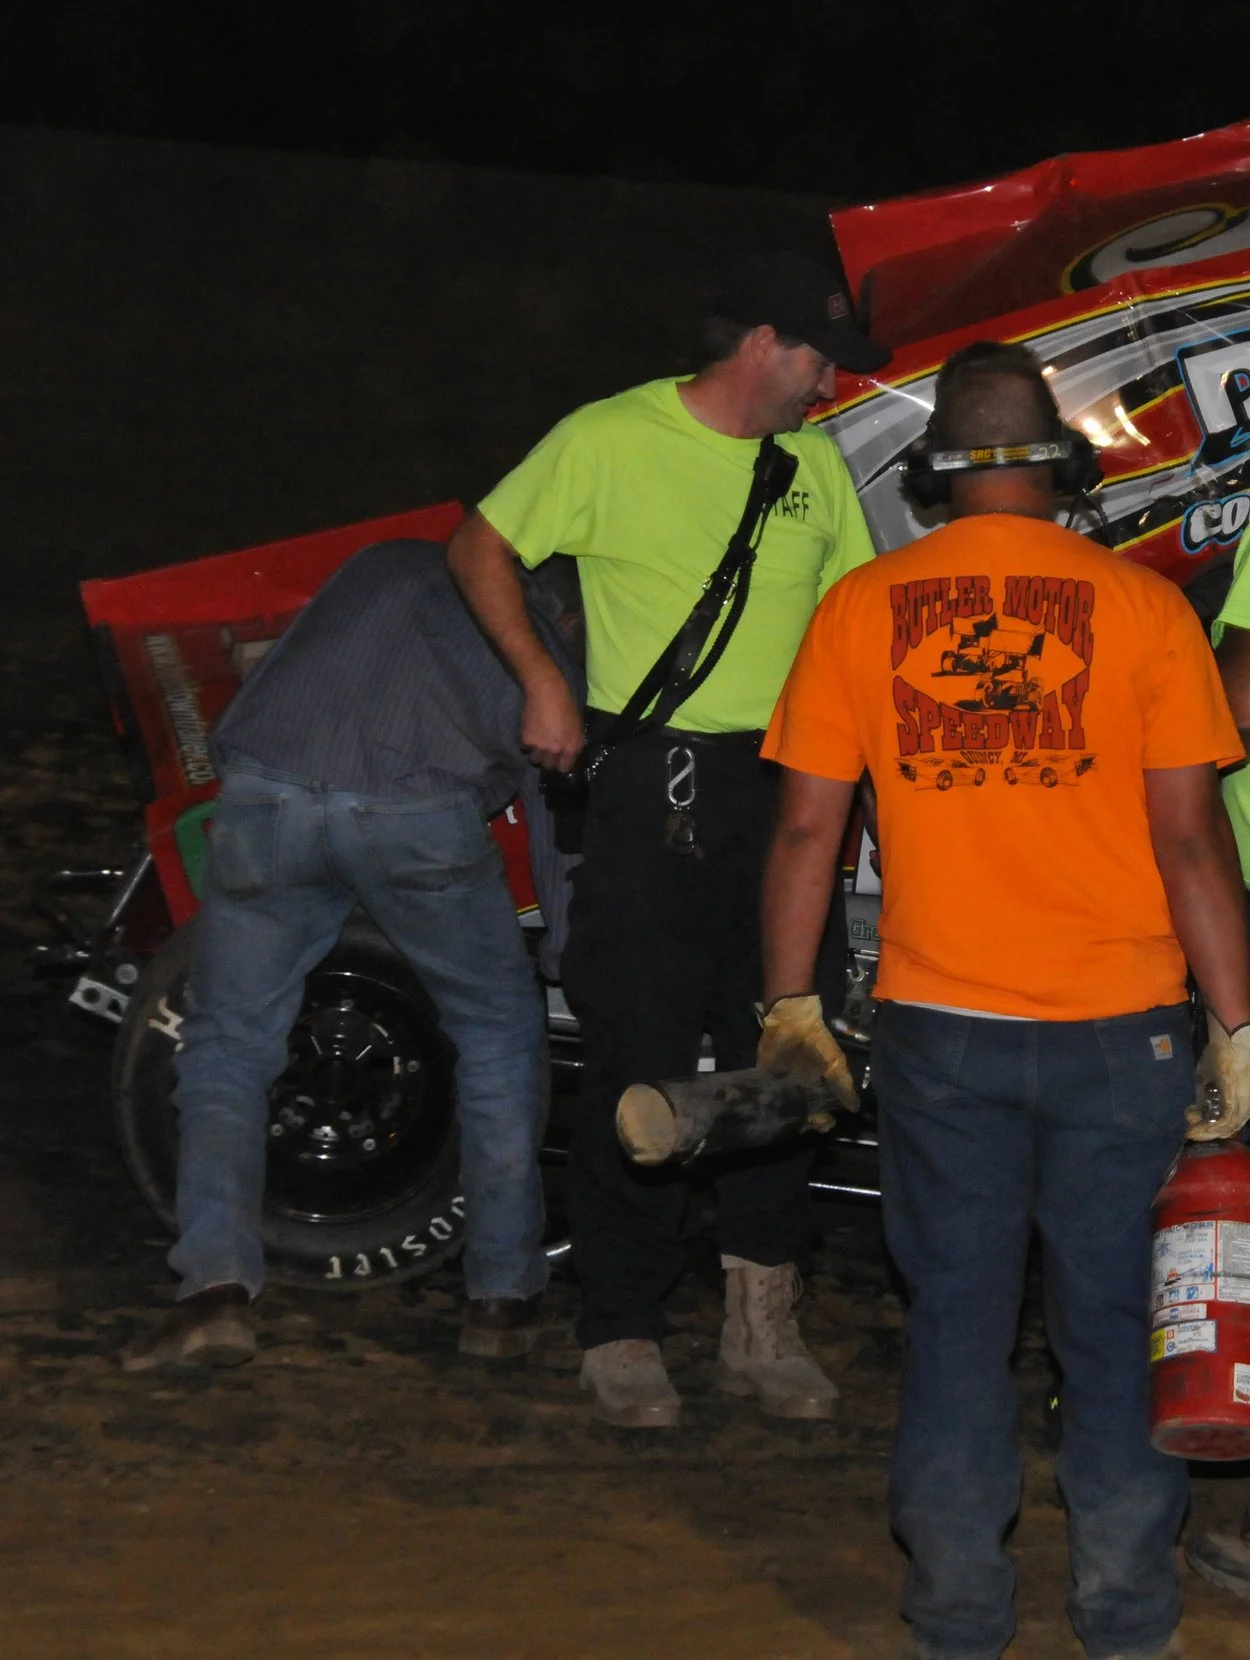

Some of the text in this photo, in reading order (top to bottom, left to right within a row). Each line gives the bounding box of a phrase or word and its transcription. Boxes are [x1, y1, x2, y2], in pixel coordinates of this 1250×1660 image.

[890, 575, 1096, 671] BUTLER MOTOR
[892, 667, 1090, 757] SPEEDWAY
